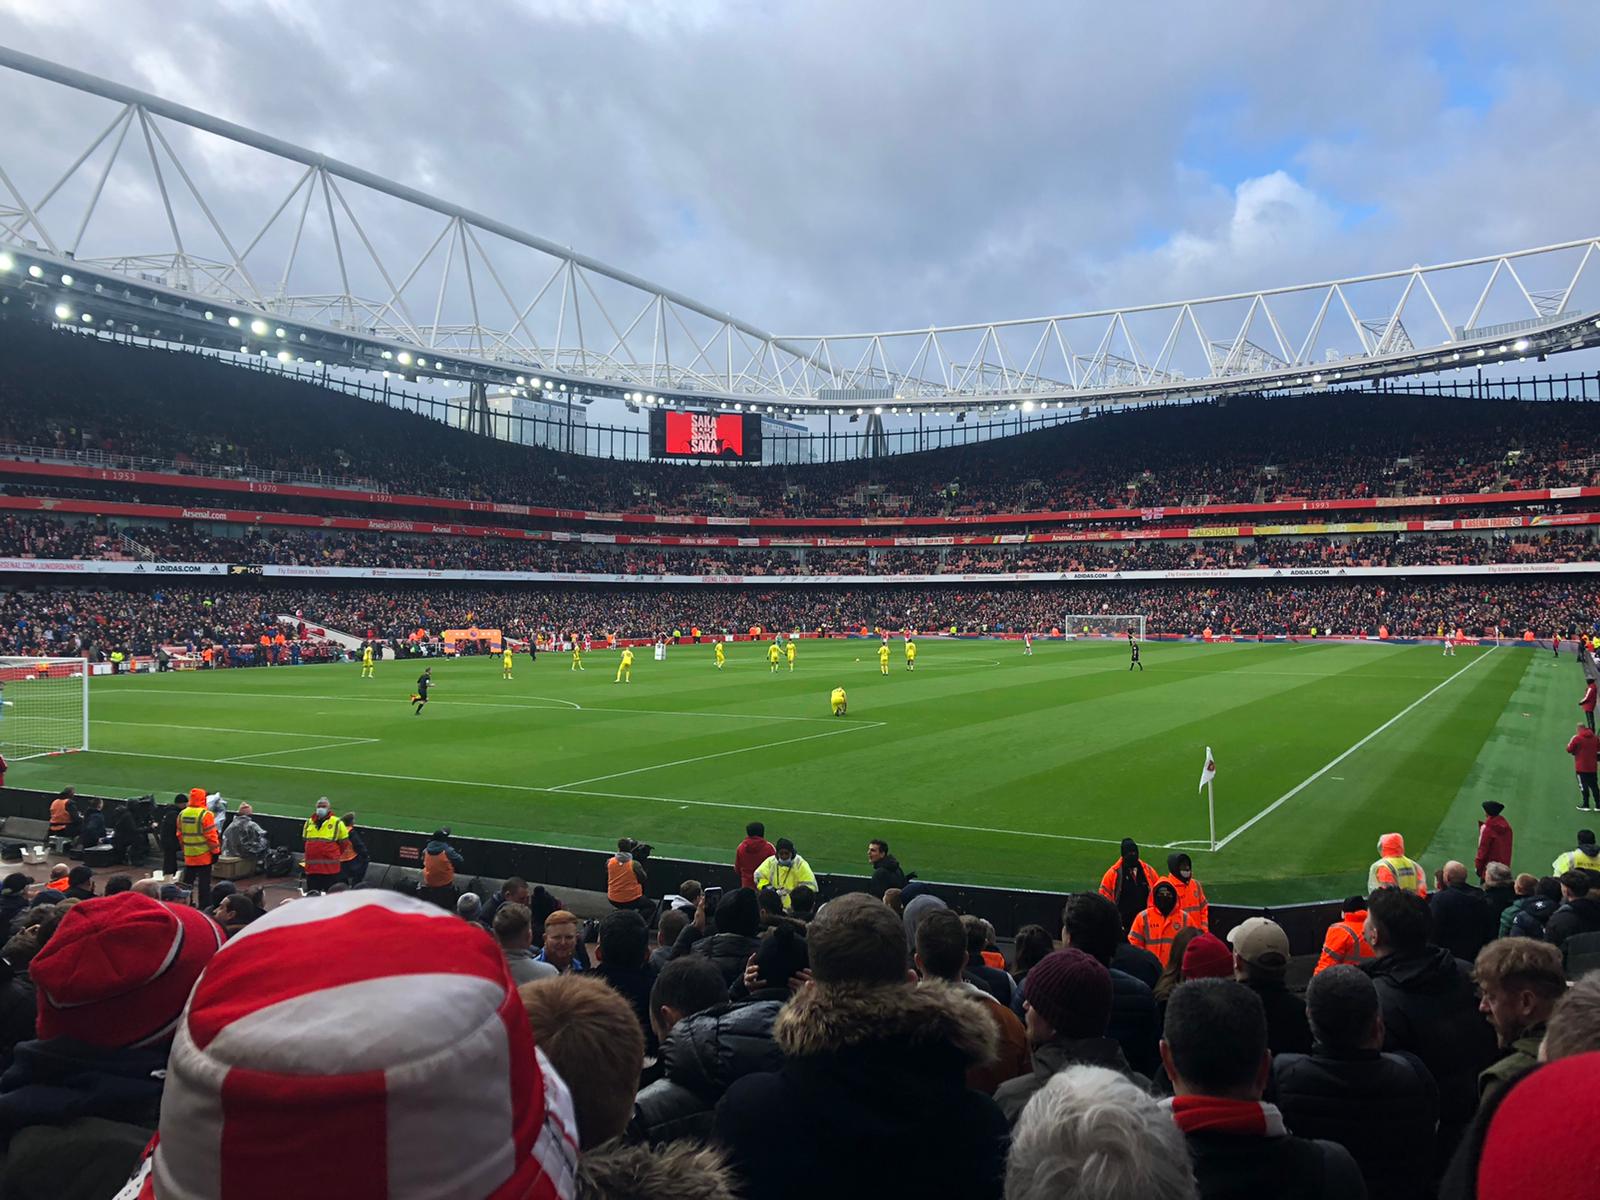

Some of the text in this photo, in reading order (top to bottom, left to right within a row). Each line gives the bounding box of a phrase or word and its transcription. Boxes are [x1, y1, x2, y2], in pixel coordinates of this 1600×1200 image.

[691, 415, 718, 428] SAKA
[691, 427, 718, 440] SAKA
[691, 440, 718, 453] SAKA
[112, 471, 136, 481] 1953
[258, 483, 277, 493] 1970
[1444, 496, 1465, 504] 1993
[182, 508, 227, 521] Arsenal.com
[432, 525, 452, 533] Arsenal
[1195, 527, 1239, 536] AUSTRALIA
[1051, 533, 1086, 541] Arsenal.com
[154, 565, 201, 573] ADIDAS.COM
